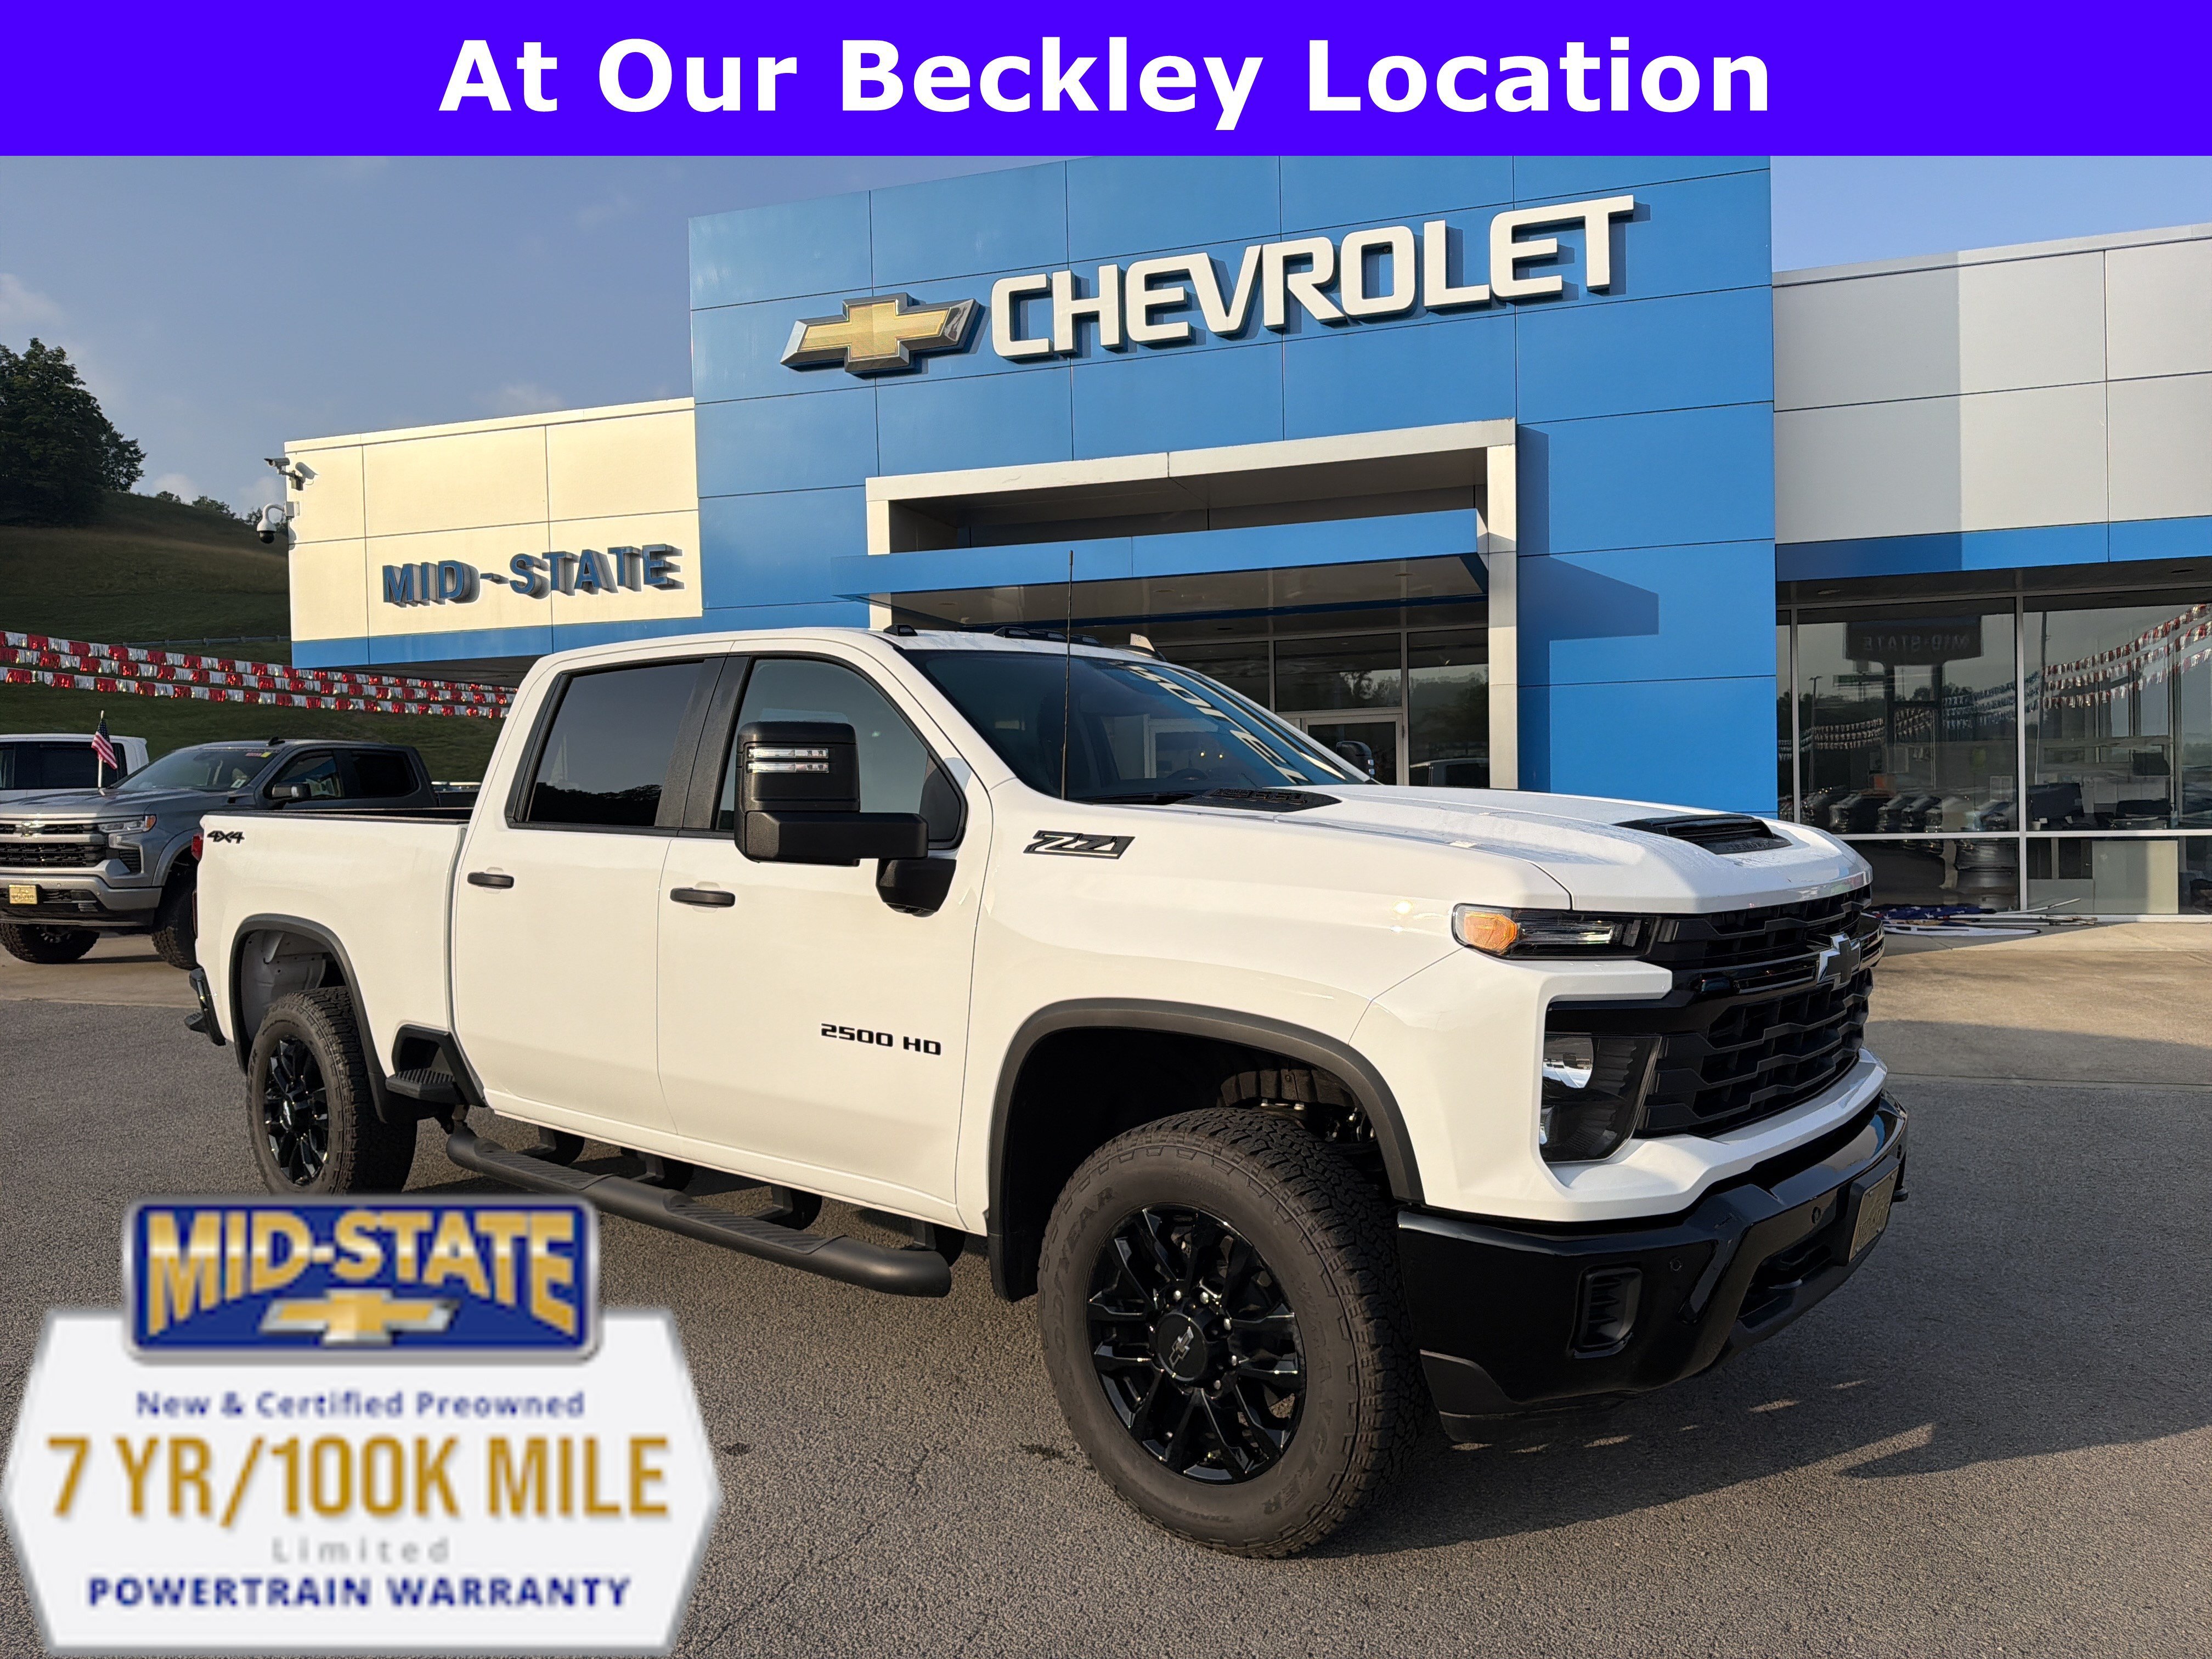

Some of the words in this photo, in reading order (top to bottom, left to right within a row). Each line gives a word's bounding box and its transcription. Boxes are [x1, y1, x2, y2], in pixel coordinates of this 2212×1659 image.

[991, 194, 1635, 358] CHEVROLET
[382, 543, 684, 608] MID-STATE
[1023, 830, 1136, 860] Z71
[821, 1023, 893, 1047] 2500
[903, 1036, 941, 1056] HD
